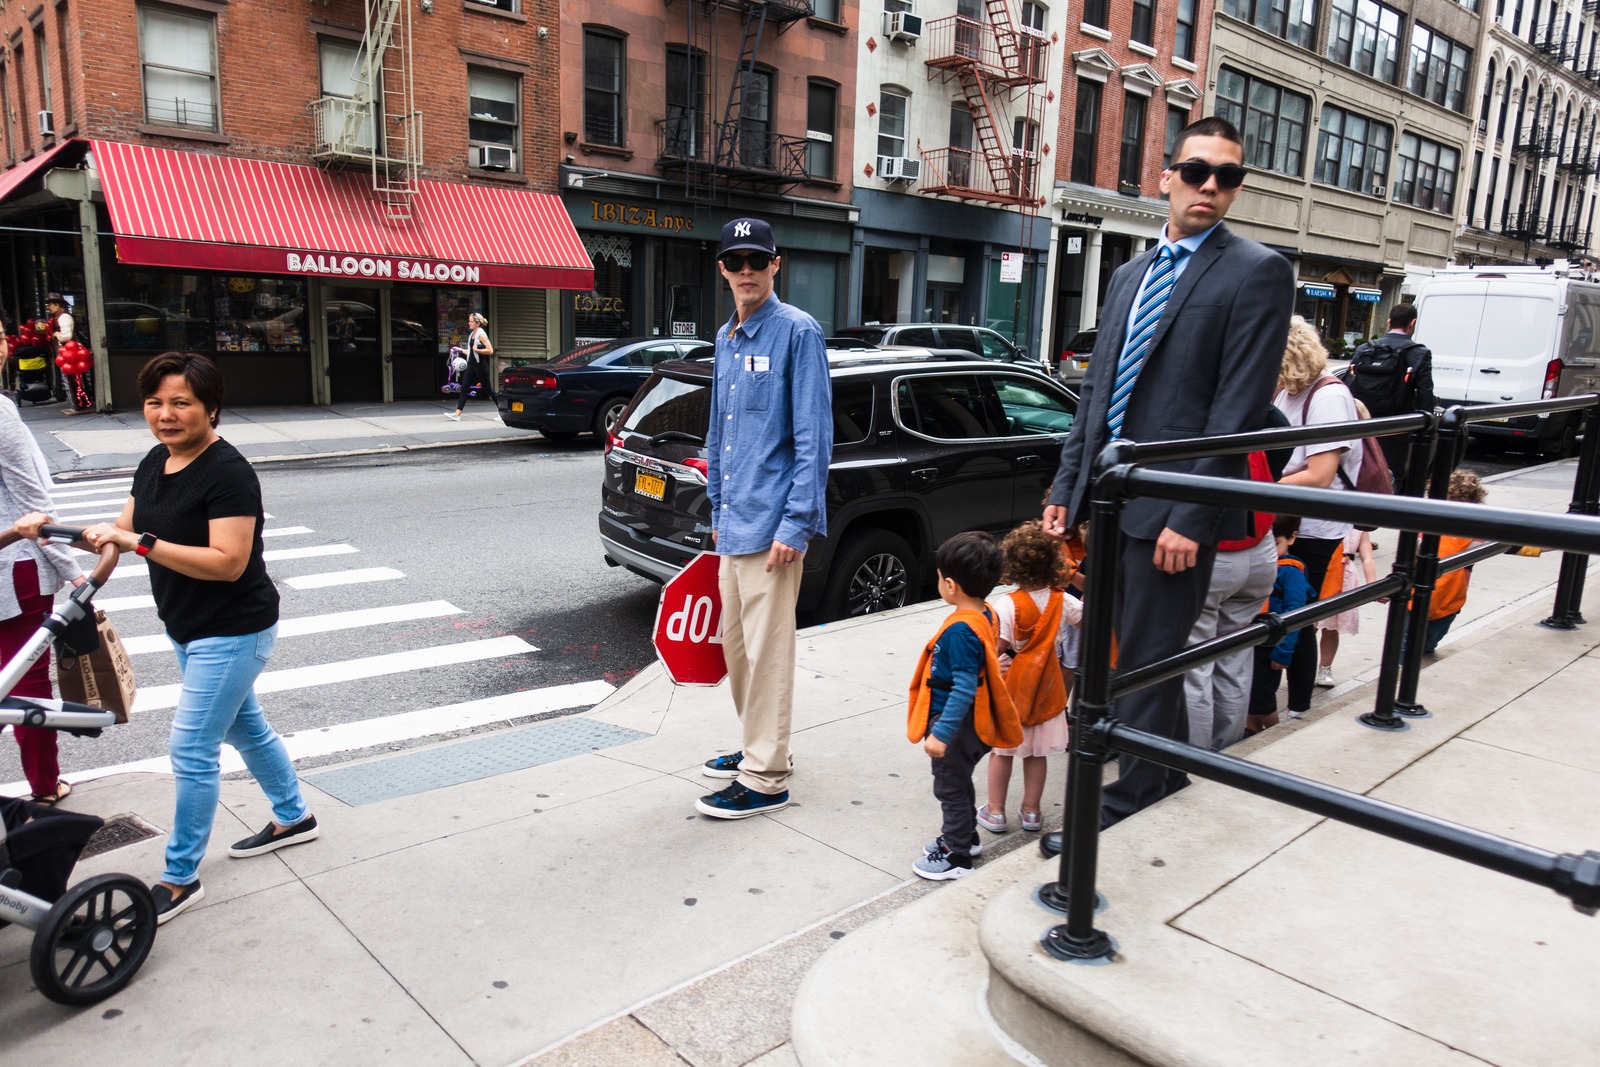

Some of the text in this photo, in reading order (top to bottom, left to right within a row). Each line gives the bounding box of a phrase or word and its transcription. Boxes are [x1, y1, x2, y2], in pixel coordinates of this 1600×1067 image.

[734, 221, 751, 237] NY
[287, 253, 480, 283] BALLOON SALOON
[674, 323, 694, 334] STORE
[634, 454, 657, 469] GMC
[666, 594, 723, 644] TOP
[27, 633, 56, 662] VISTA
[82, 655, 97, 698] CHIPOTL
